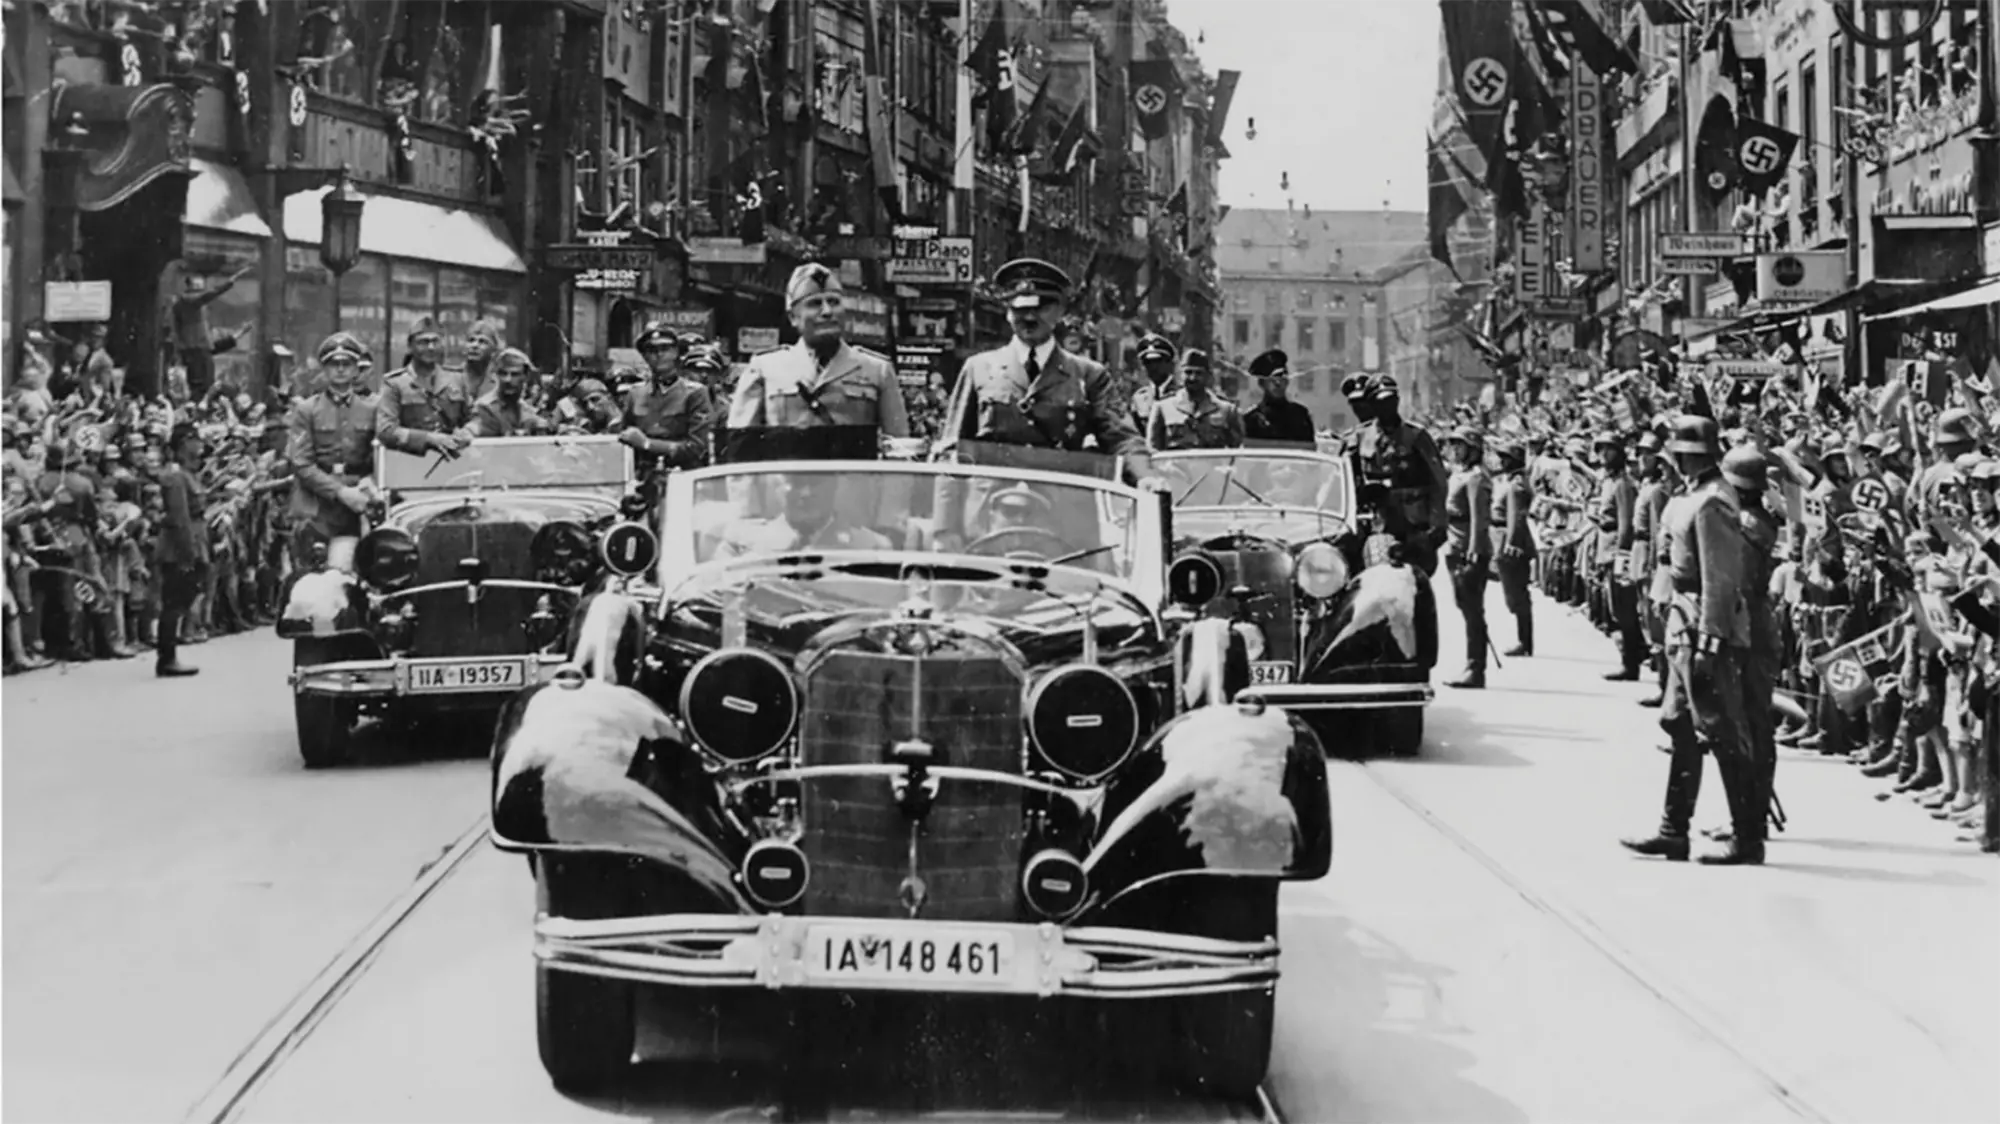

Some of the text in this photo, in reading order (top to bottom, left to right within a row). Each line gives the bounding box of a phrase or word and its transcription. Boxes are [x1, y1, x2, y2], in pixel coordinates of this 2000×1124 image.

[1577, 66, 1598, 230] LDBAUER
[929, 241, 970, 258] Piano
[460, 665, 512, 684] 19357
[1250, 666, 1285, 682] 947
[825, 937, 999, 976] IA 148 461
